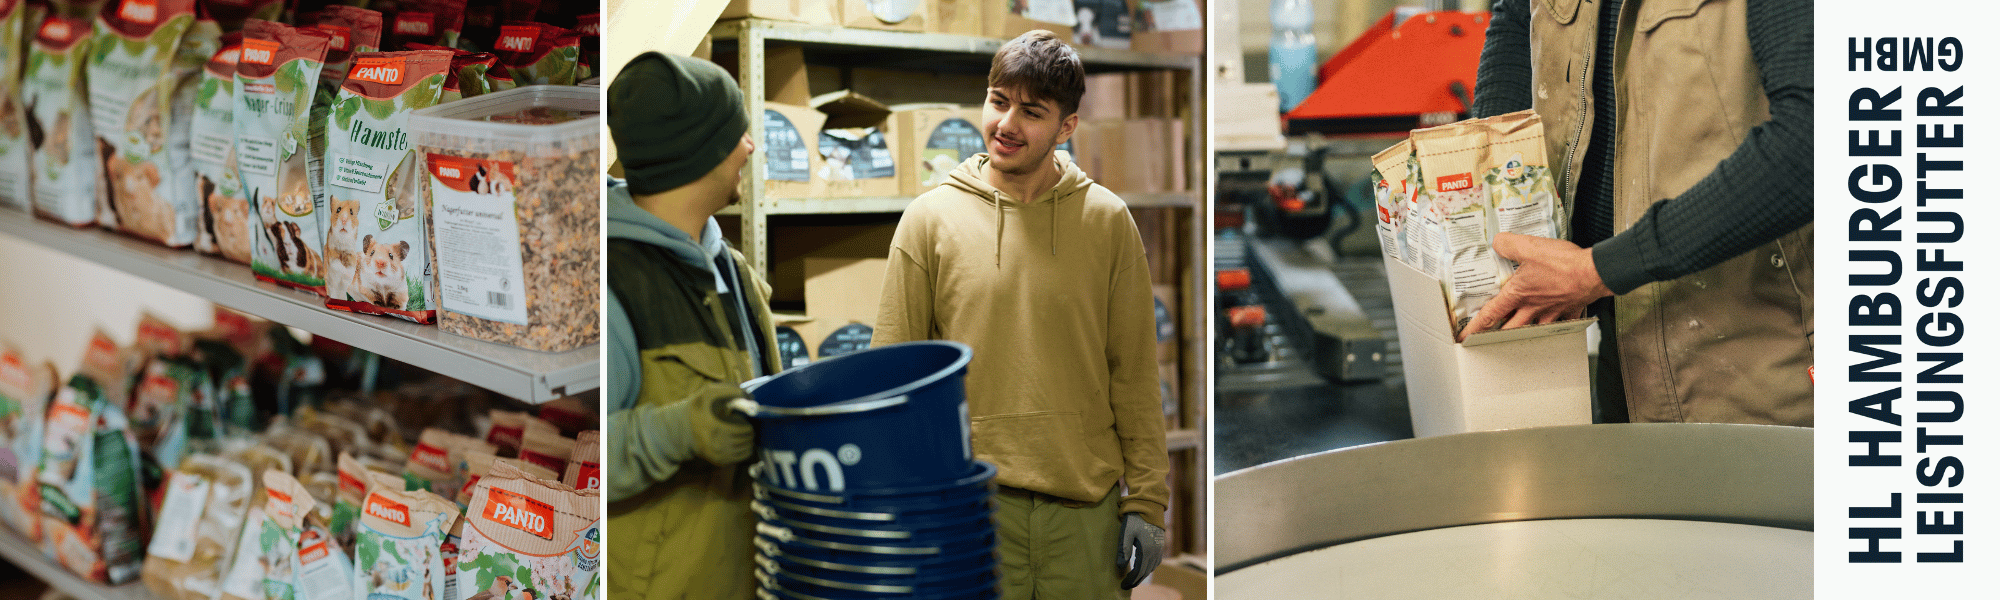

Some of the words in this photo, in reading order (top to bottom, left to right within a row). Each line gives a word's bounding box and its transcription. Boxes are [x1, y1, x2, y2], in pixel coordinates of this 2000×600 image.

[356, 67, 399, 82] PANTO
[1442, 179, 1469, 191] PANTO
[370, 503, 405, 523] PANTO
[493, 502, 545, 532] PANTO
